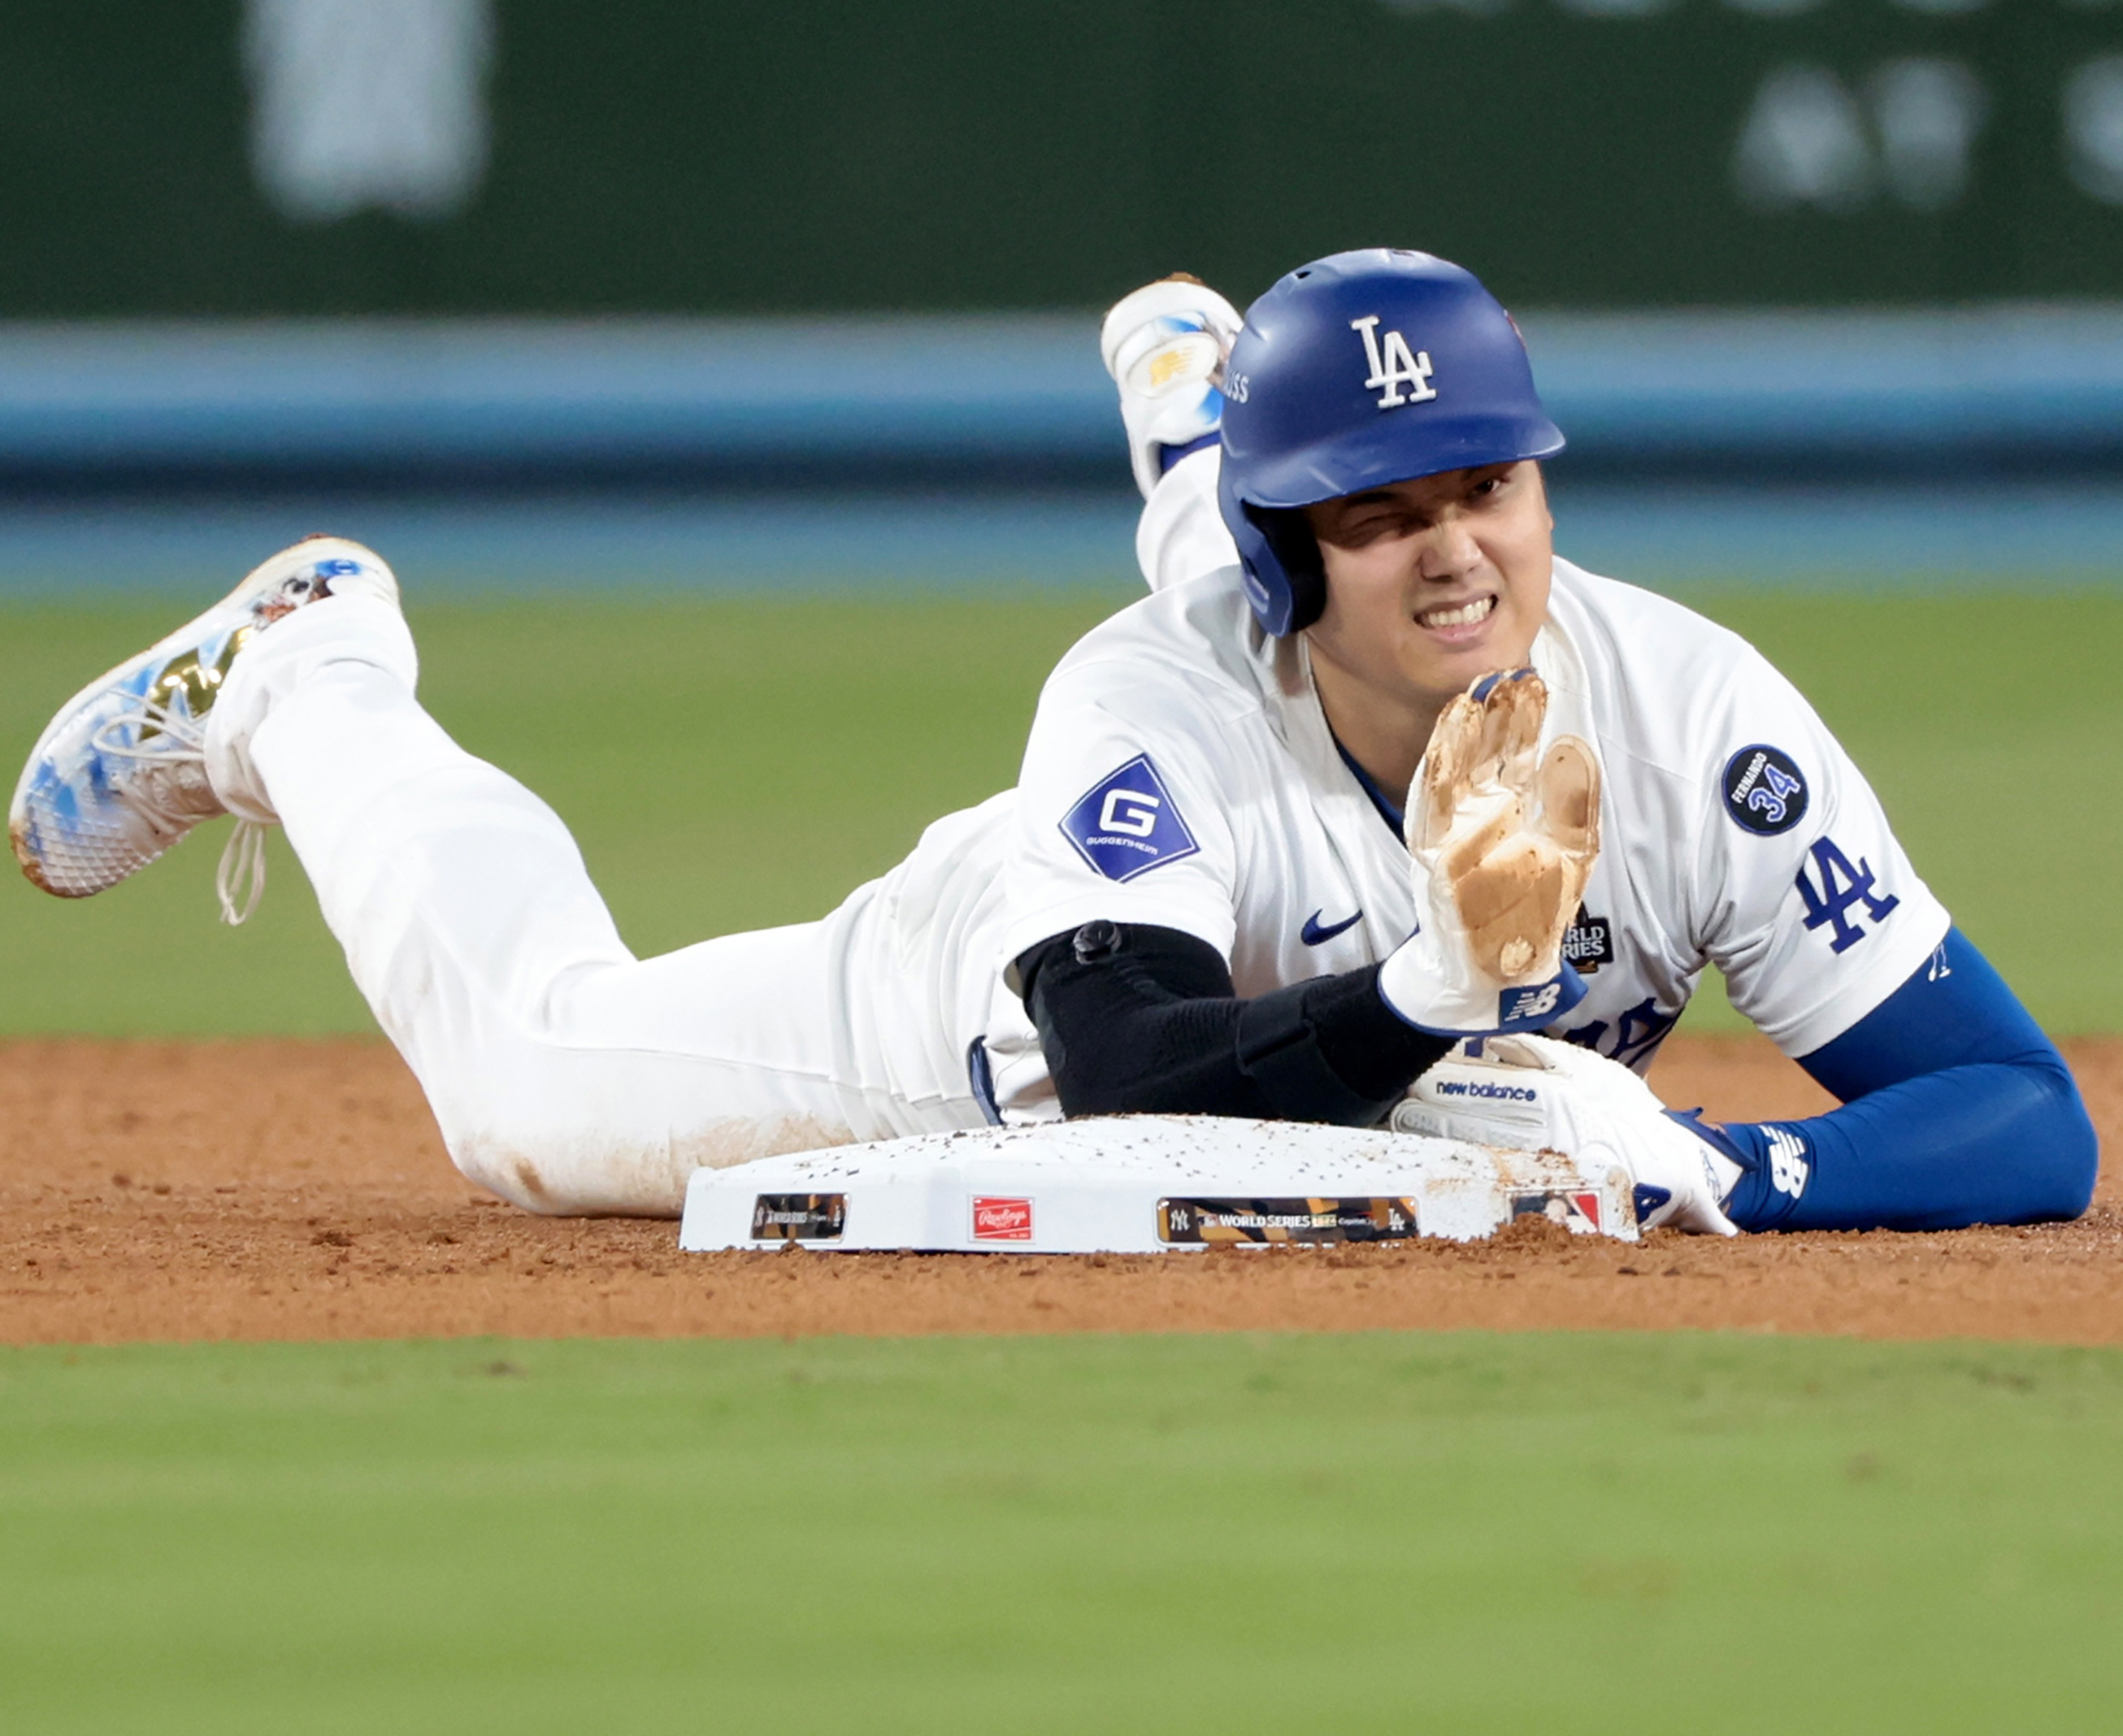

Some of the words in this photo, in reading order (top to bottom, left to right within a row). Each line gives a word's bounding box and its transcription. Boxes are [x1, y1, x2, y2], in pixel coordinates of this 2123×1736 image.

[1351, 316, 1437, 409] LA
[1731, 752, 1768, 803] FERNANDO
[1747, 763, 1801, 822] 34
[1100, 788, 1160, 837] G
[1086, 836, 1158, 856] GUGGENHEIM
[1795, 836, 1900, 954] LA
[1562, 940, 1605, 960] RIES
[1567, 926, 1605, 942] RLD
[1437, 1081, 1467, 1096] new
[1468, 1081, 1536, 1101] balance
[1219, 1214, 1266, 1227] WORLD
[1267, 1214, 1311, 1228] SERIES
